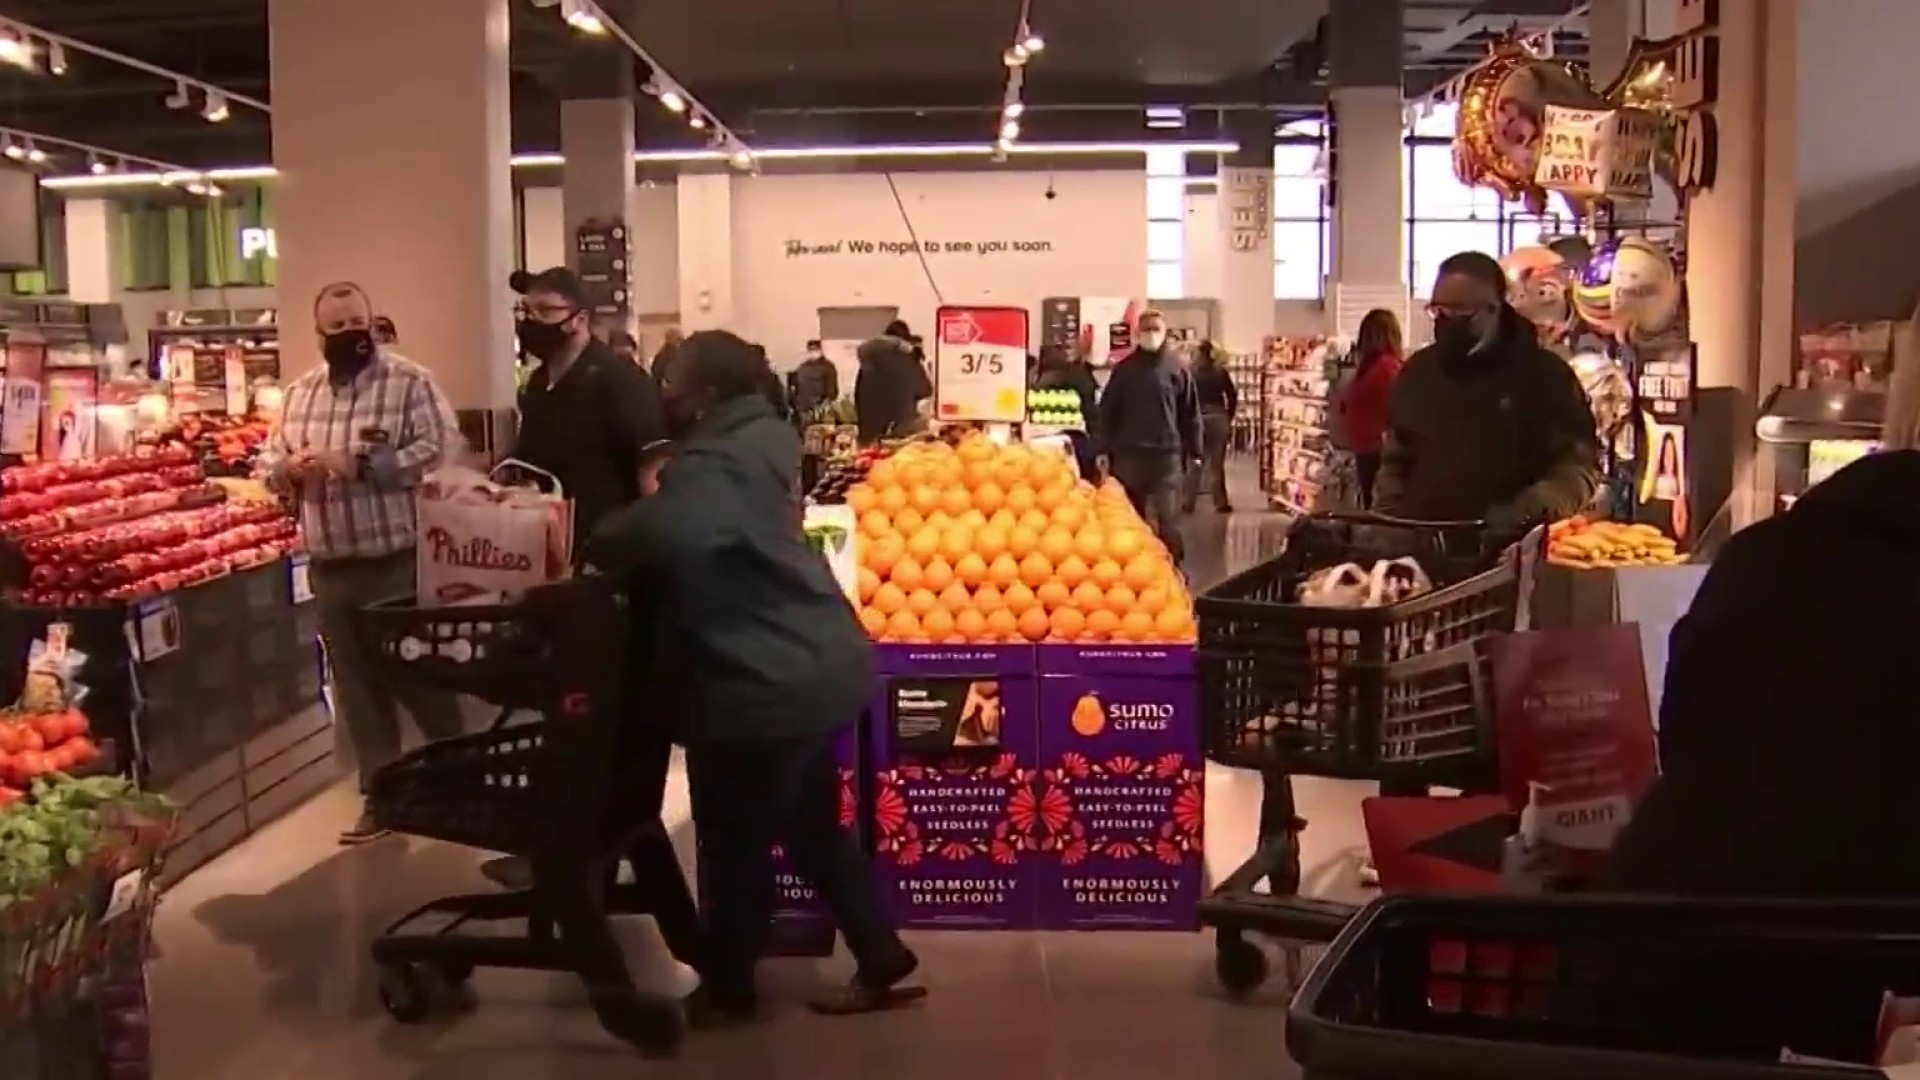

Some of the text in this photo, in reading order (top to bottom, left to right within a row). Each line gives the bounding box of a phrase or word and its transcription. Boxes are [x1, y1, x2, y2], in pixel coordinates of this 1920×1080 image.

[847, 239, 874, 253] We
[878, 240, 918, 256] hope
[924, 240, 940, 252] to
[944, 241, 972, 252] see
[977, 241, 1007, 255] you
[426, 526, 532, 571] Phillies
[1114, 719, 1168, 731] CITRUS
[908, 787, 1006, 797] HANDCRAFTED
[1074, 786, 1173, 796] HANDCRAFTED
[913, 803, 1001, 813] EASY-TO-PEEL
[1078, 803, 1167, 813] EASY-TO-PEEL
[1556, 804, 1616, 829] GIANT
[927, 820, 989, 830] SEEDLESS
[1092, 819, 1155, 830] SEEDLESS
[899, 878, 1018, 890] ENORMOUSLY
[1063, 878, 1181, 890] ENORMOUSLY
[912, 893, 1004, 904] DELICIOUS
[1075, 892, 1168, 903] DELICIOUS
